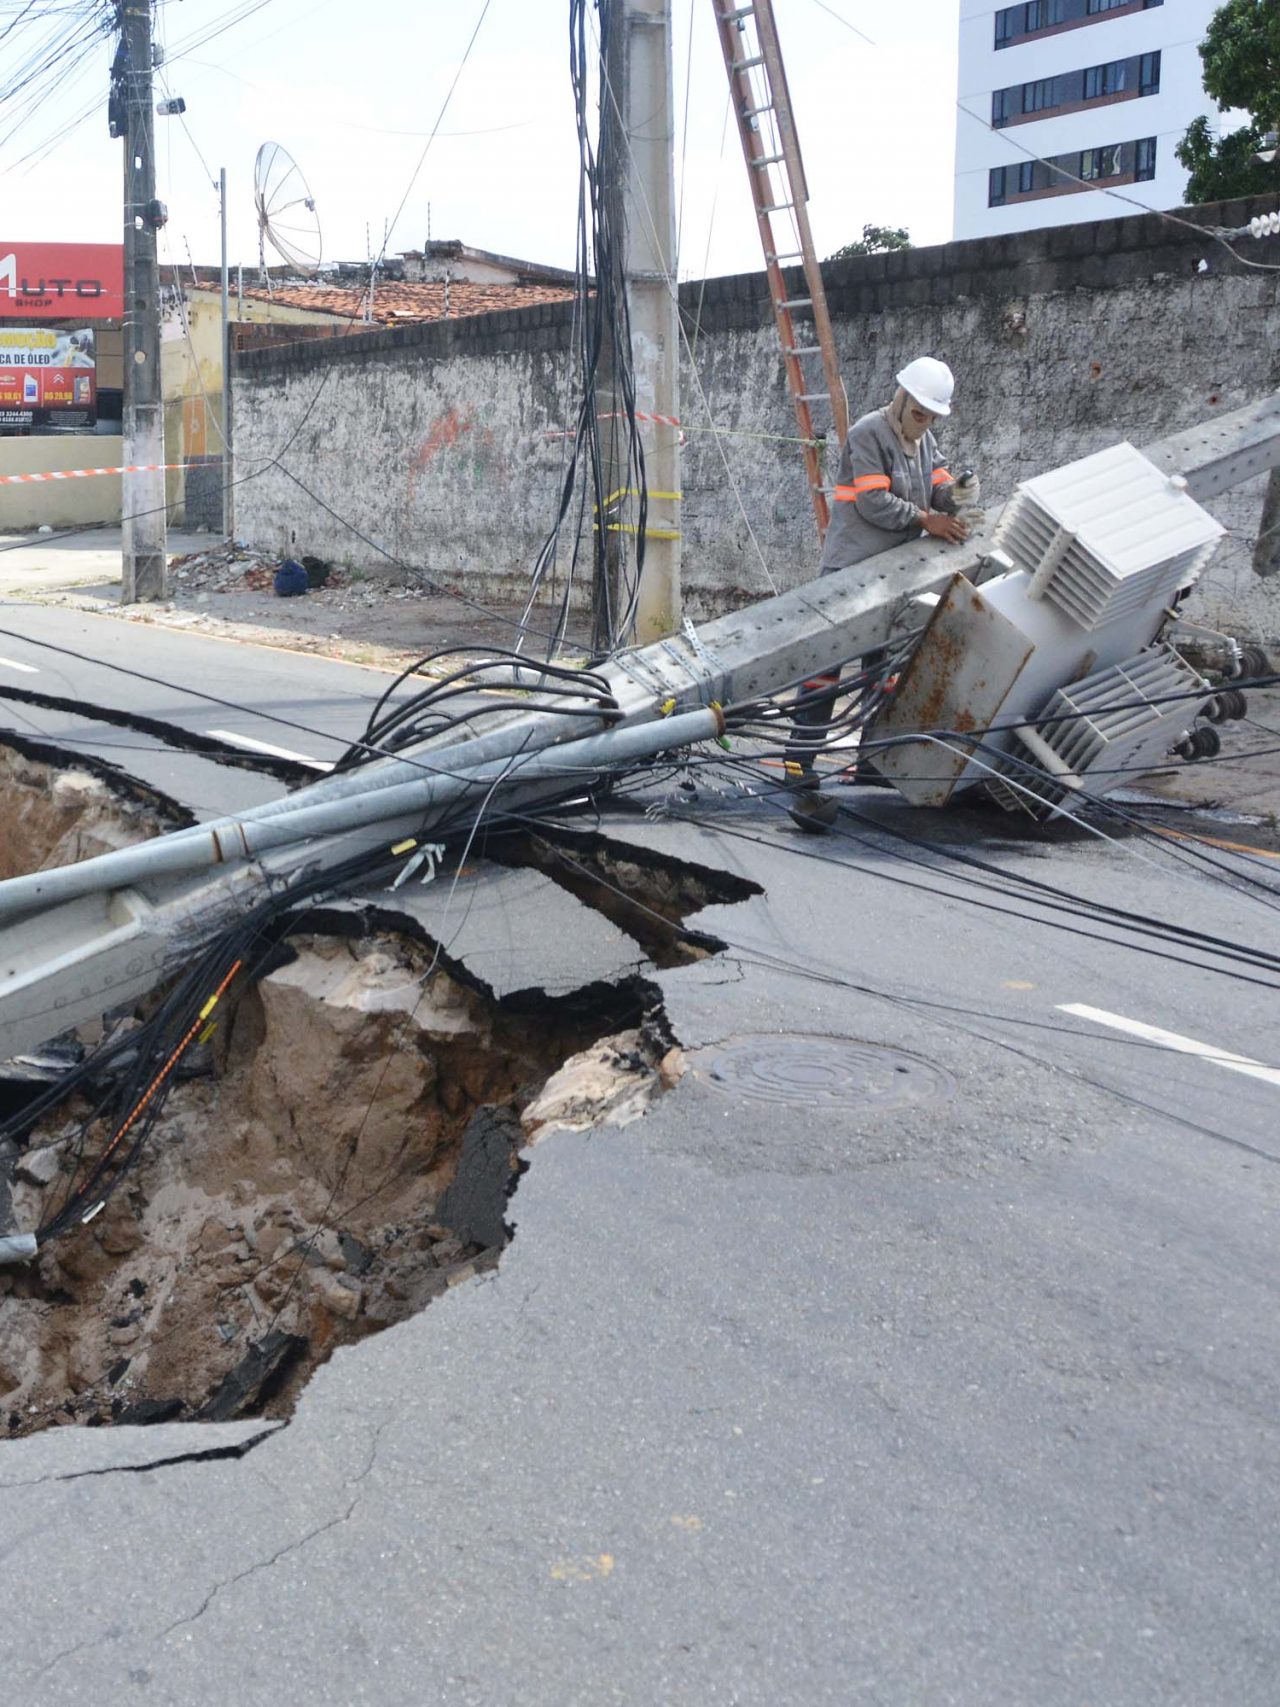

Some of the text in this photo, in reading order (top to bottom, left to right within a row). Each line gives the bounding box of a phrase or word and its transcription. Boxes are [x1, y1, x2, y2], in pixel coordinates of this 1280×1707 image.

[16, 299, 53, 308] SHOP
[14, 354, 25, 365] DE
[27, 351, 50, 365] ÓLEO
